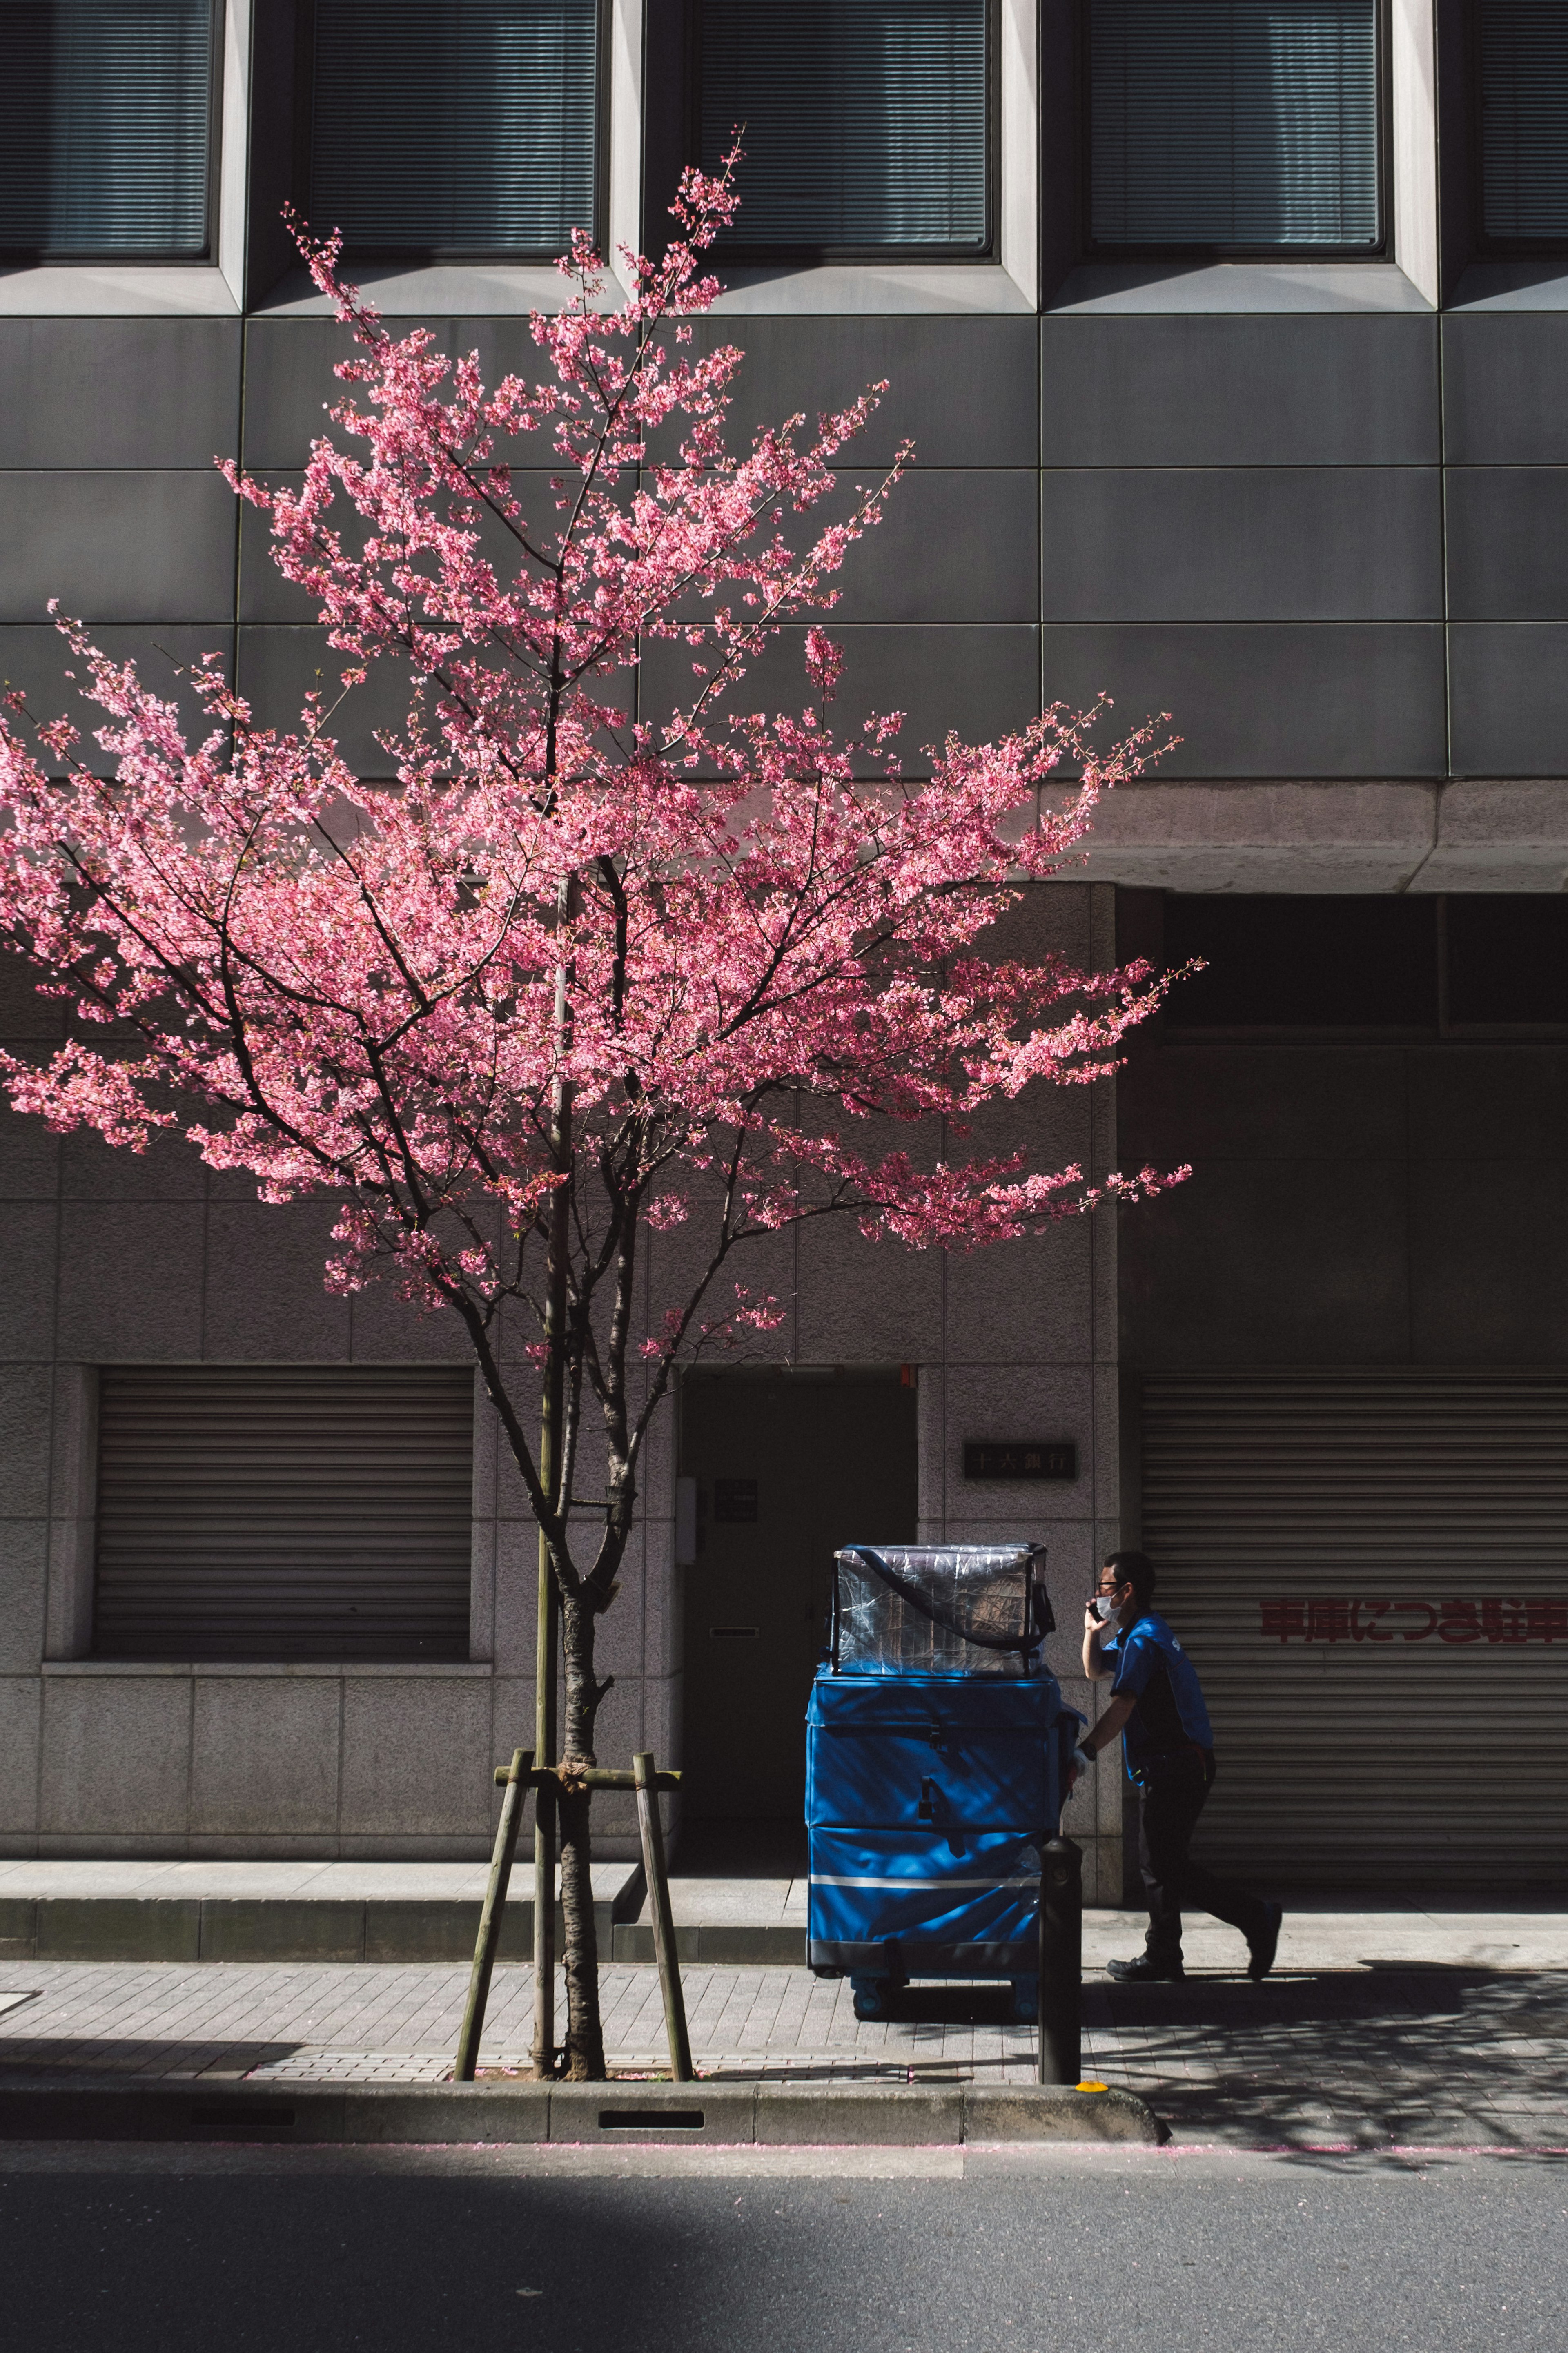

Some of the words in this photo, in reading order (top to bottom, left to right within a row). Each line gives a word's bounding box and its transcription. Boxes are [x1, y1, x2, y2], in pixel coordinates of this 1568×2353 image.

[973, 1452, 1066, 1470] 十六銀行
[1259, 1598, 1568, 1643] 車庫につき駐車
